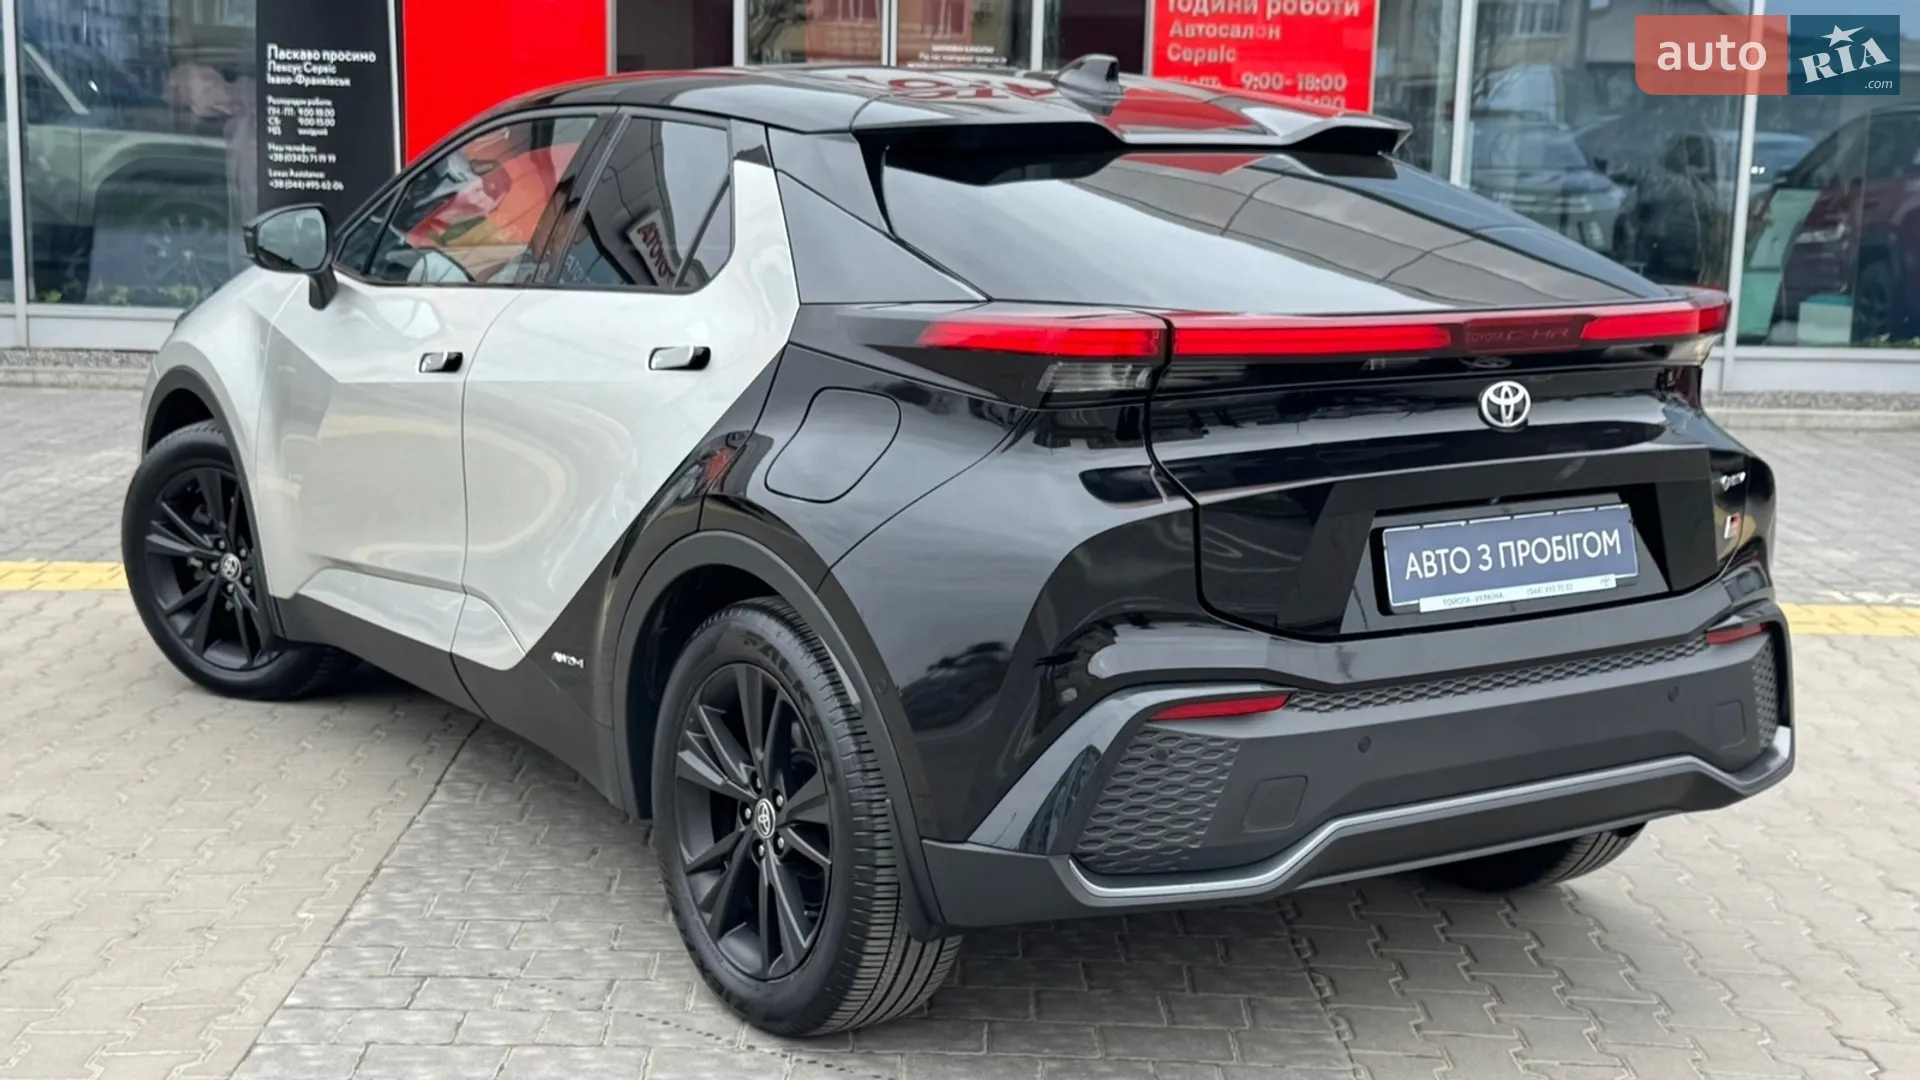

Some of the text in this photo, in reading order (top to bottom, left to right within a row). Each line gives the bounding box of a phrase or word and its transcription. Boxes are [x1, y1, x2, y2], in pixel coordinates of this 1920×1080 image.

[1169, 20, 1281, 40] Автосалон
[322, 50, 376, 63] просимо
[1167, 43, 1238, 66] Сервіс
[1405, 546, 1471, 580] АВТО
[1498, 528, 1622, 569] ПРОБІГОМ
